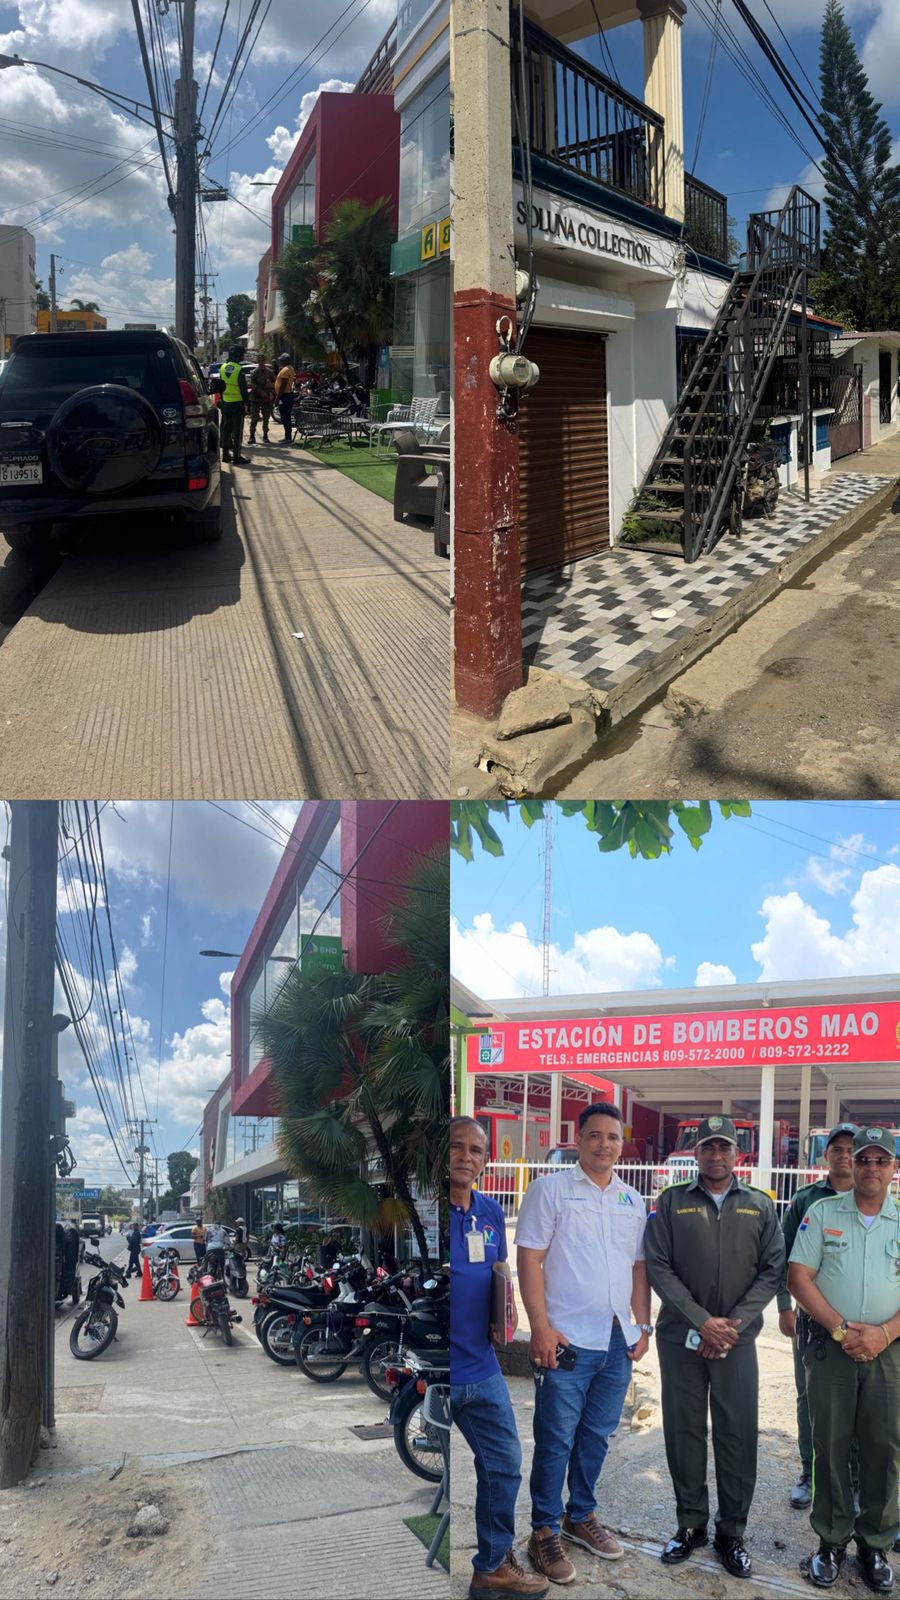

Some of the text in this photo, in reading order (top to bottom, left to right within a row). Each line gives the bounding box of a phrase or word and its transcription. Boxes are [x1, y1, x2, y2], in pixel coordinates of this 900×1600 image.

[516, 201, 651, 264] SOLUNA COLLECTION
[320, 946, 337, 955] BHD
[518, 1012, 879, 1050] ESTACIÓN DE BOMBEROS MAO
[539, 1054, 574, 1065] TELS.:
[576, 1051, 659, 1065] EMERGENCIAS
[663, 1047, 745, 1062] 809-572-2000
[759, 1043, 849, 1059] 809-572-3222
